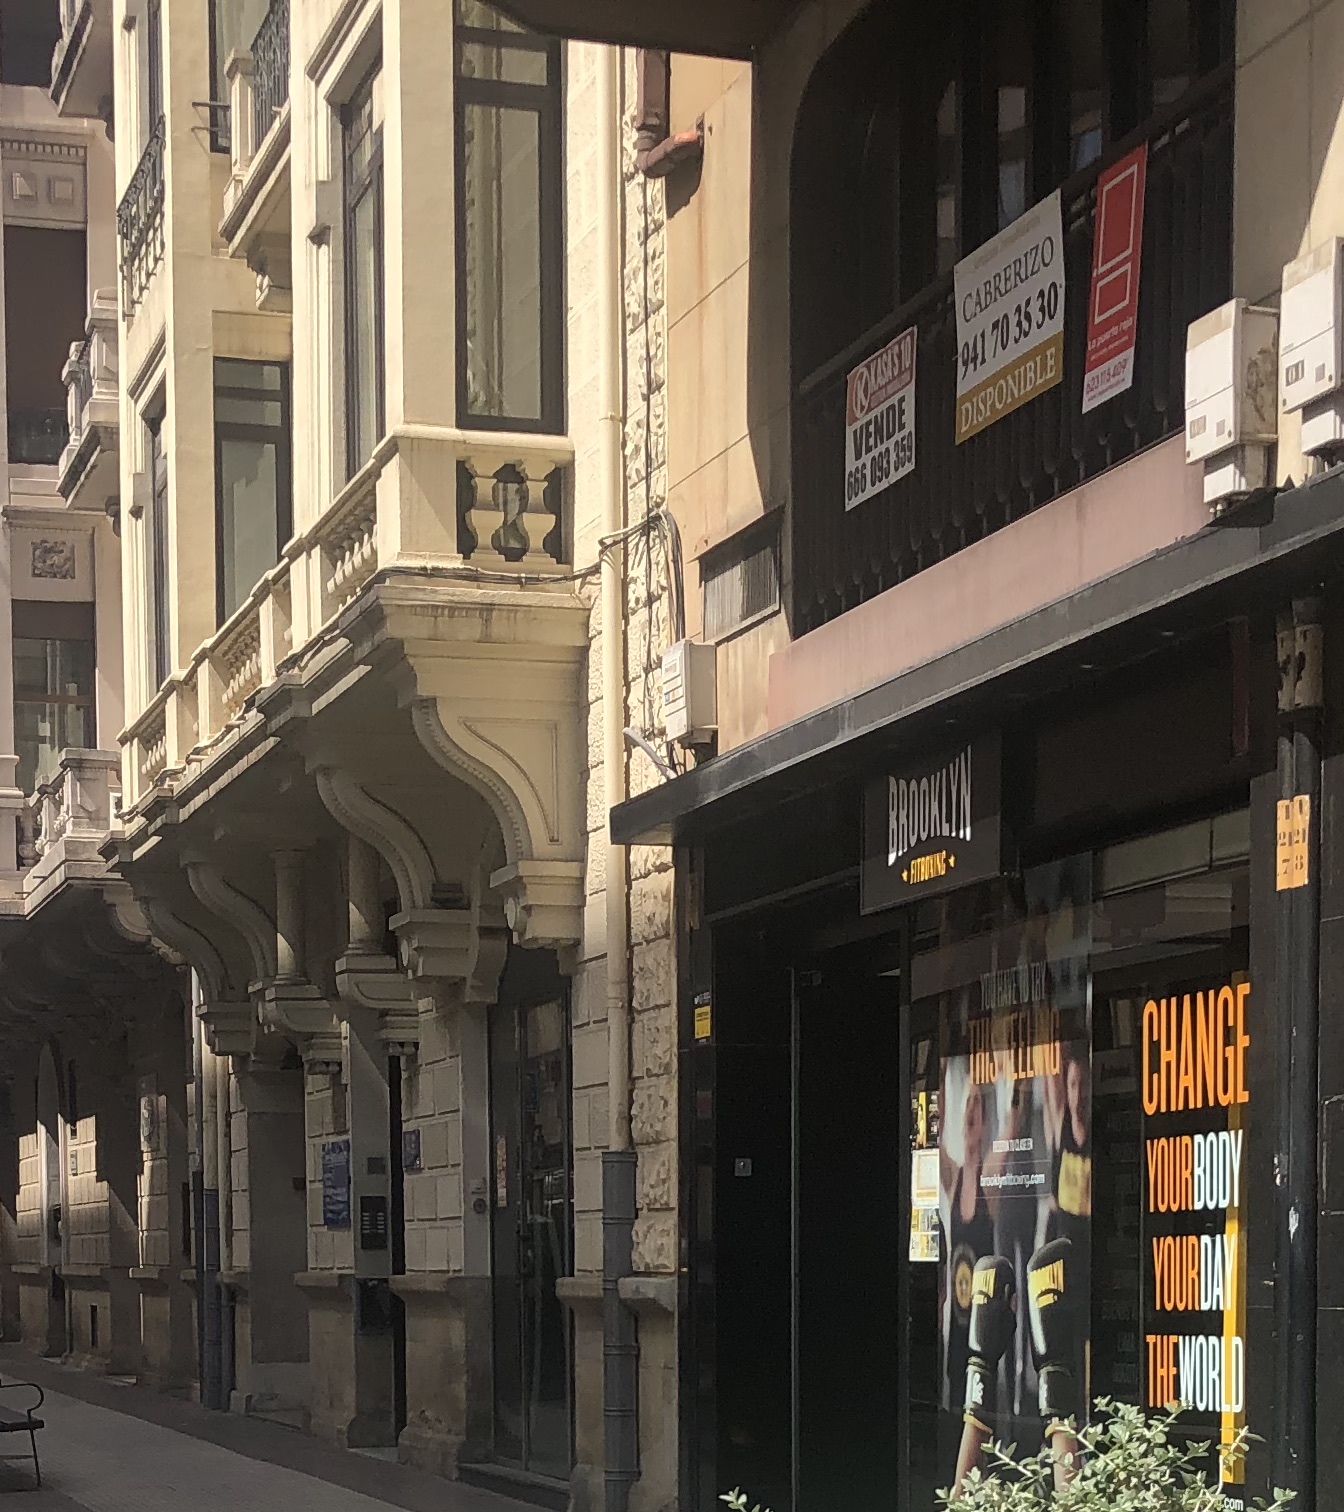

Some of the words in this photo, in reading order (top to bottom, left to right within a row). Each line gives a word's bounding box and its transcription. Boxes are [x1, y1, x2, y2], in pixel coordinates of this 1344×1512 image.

[962, 236, 1054, 323] CABRERIZO
[961, 328, 987, 381] 941
[990, 312, 1010, 358] 70
[1014, 297, 1033, 344] 35
[1036, 281, 1058, 331] 30
[852, 394, 906, 462] VENDE
[960, 347, 1056, 434] DISPONIBLE
[847, 461, 867, 502] 666
[870, 447, 891, 487] 093
[893, 430, 913, 473] 359
[888, 744, 972, 867] BROOKLYN
[1142, 982, 1251, 1115] CHANGE
